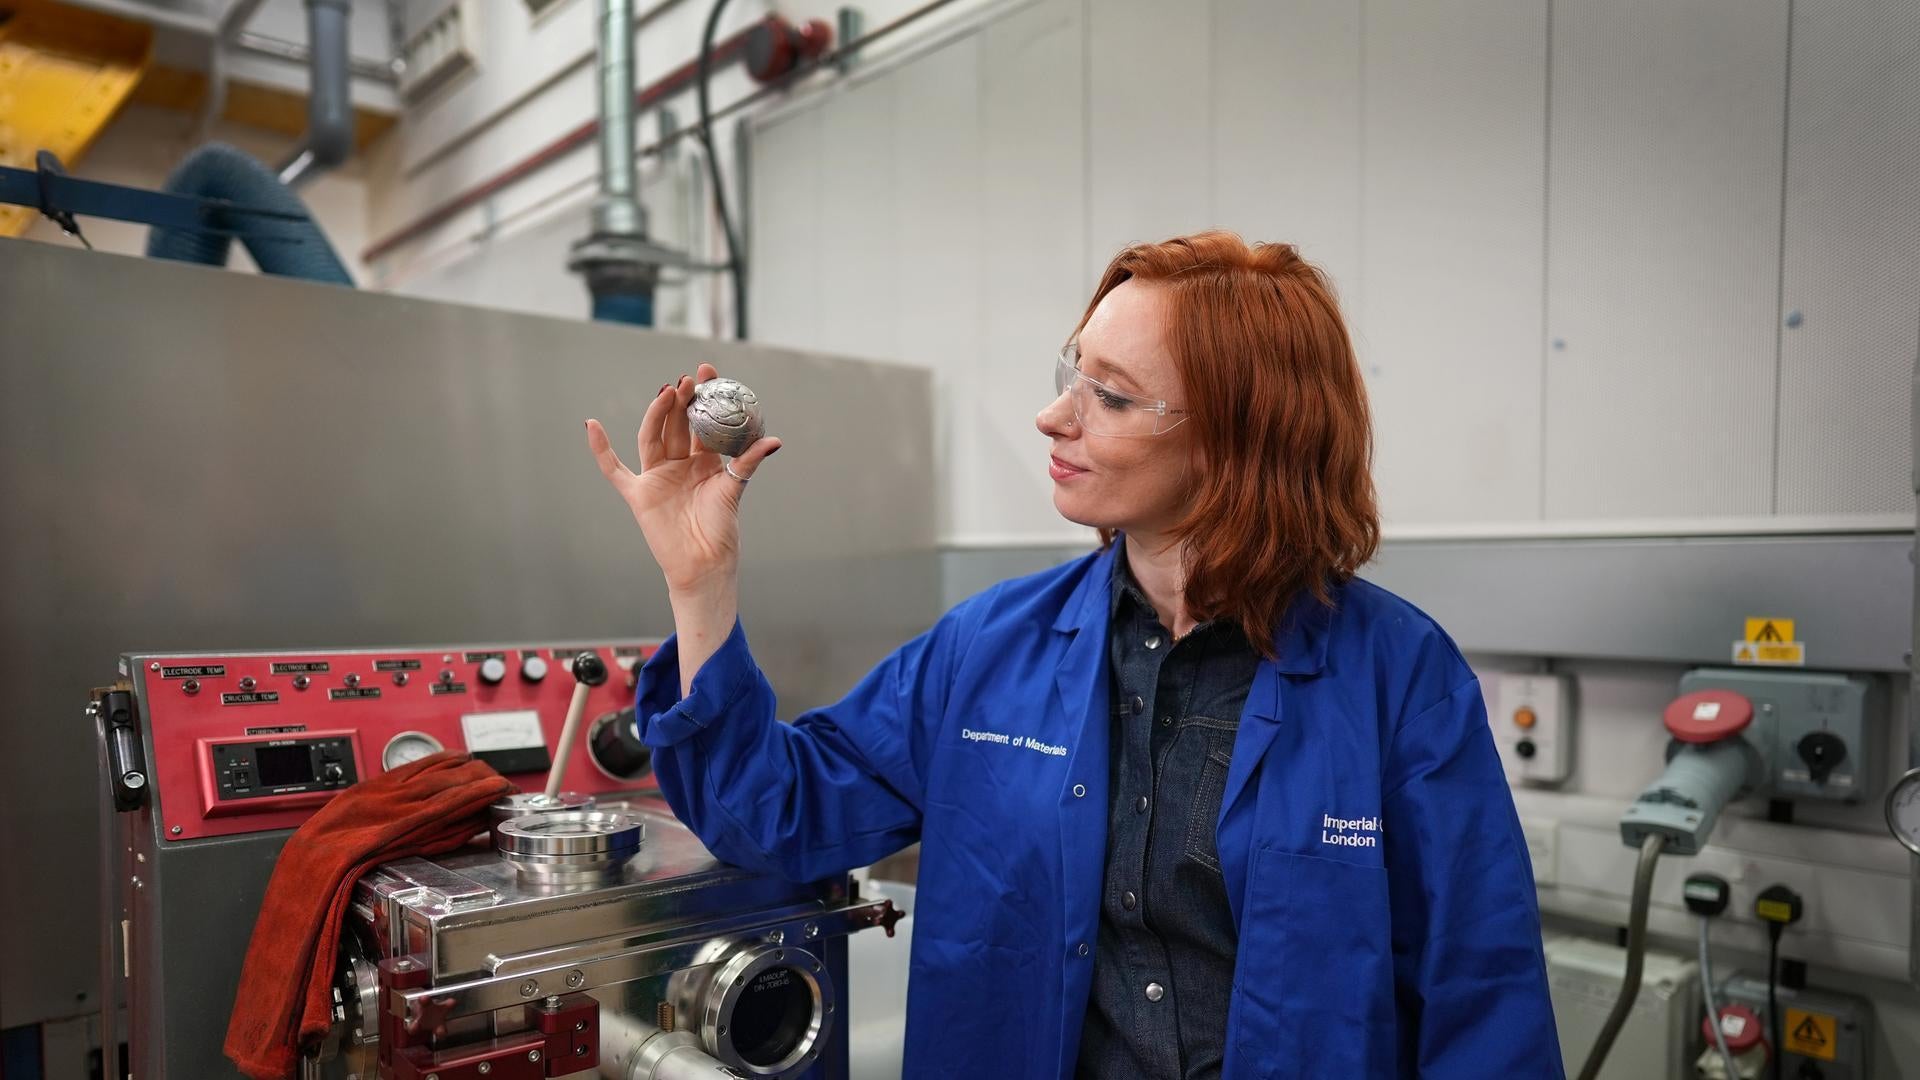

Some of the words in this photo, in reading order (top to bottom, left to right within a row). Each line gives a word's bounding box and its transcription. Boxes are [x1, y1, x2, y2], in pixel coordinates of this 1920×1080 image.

[163, 667, 202, 676] ELECTRODE
[206, 666, 224, 675] TEMP
[261, 692, 278, 701] TEMP
[962, 728, 1009, 744] Department
[1013, 736, 1024, 747] of
[1025, 737, 1067, 756] Materials
[1323, 814, 1377, 833] Imperial
[1322, 830, 1376, 847] London
